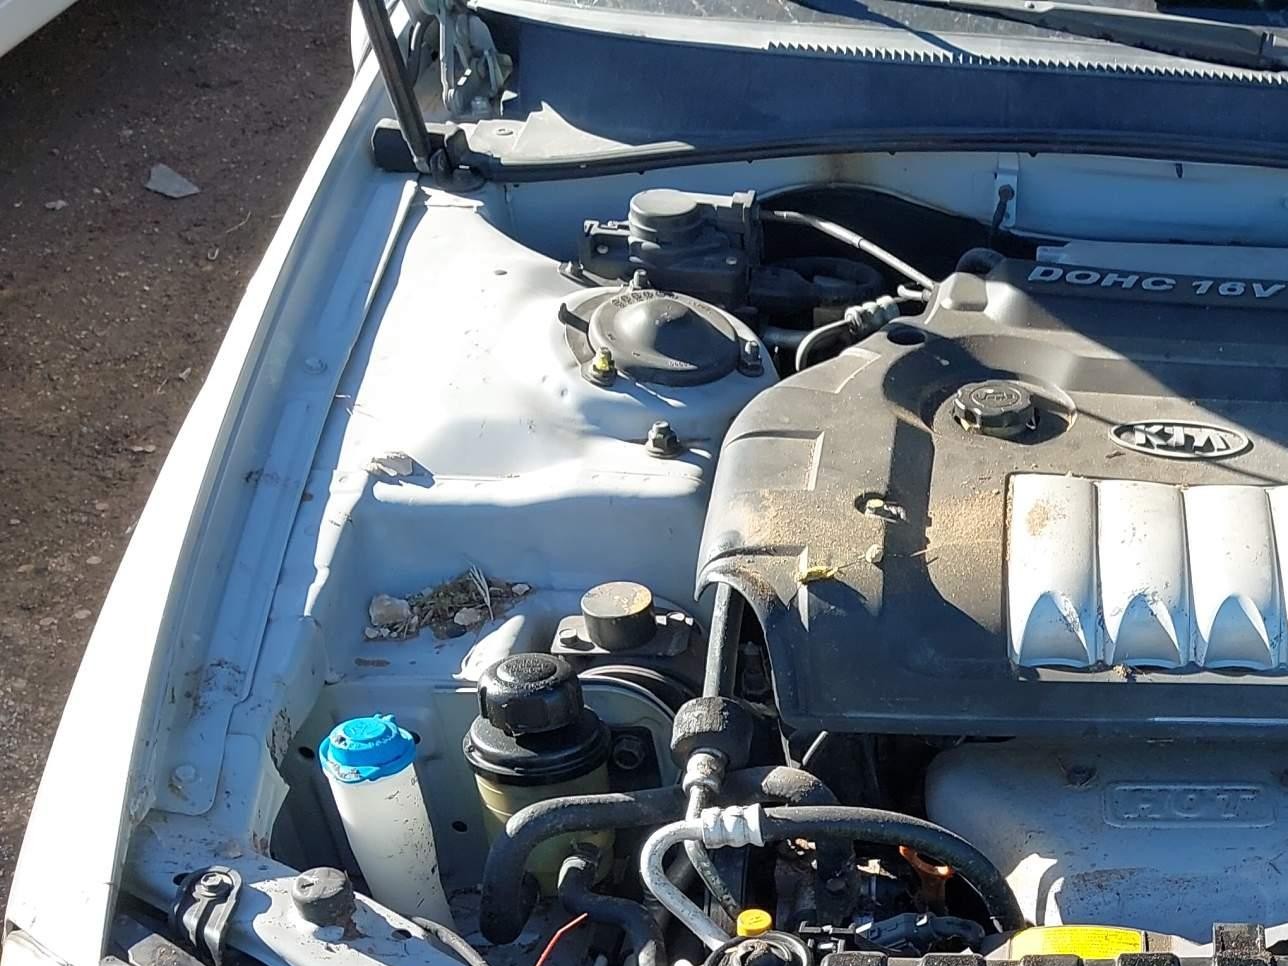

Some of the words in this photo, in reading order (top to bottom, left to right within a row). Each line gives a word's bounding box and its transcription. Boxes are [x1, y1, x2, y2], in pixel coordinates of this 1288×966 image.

[1028, 265, 1176, 291] DOHC
[1192, 279, 1286, 298] 16V
[1133, 424, 1232, 451] KIA
